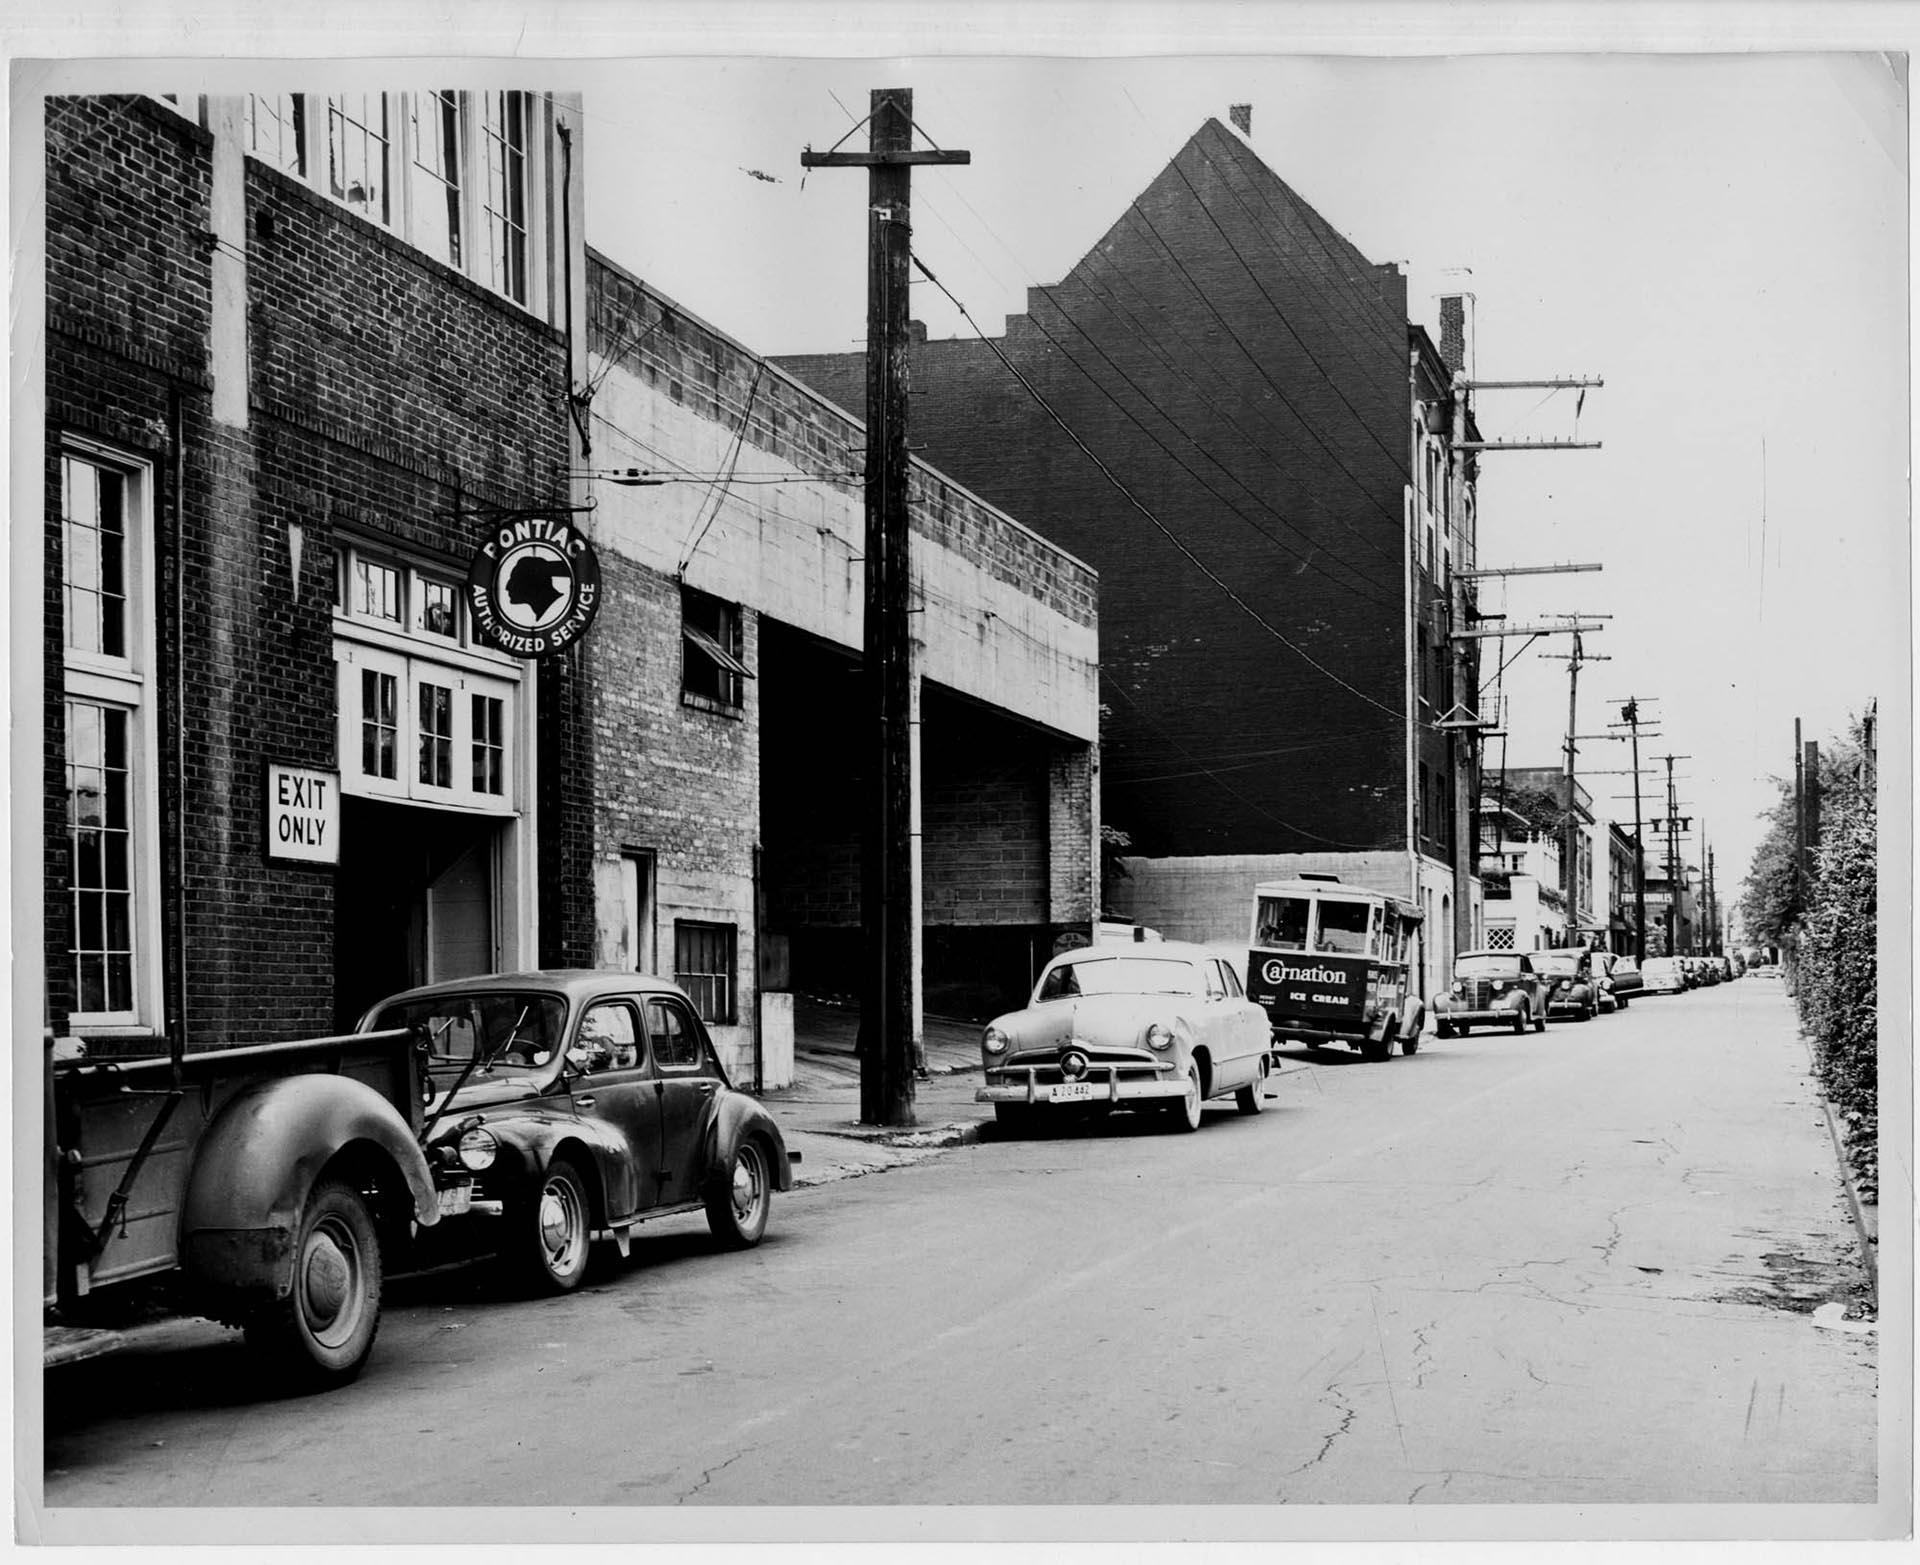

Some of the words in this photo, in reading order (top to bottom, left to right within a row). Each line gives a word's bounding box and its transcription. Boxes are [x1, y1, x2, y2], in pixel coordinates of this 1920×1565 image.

[483, 519, 586, 560] PONTIAC
[473, 584, 545, 652] AUTHORIZED
[551, 583, 595, 647] SERVICE
[278, 773, 326, 810] EXIT
[278, 814, 326, 846] ONLY
[1261, 958, 1347, 985] Carnation
[1289, 992, 1307, 1001] ICE
[1311, 993, 1349, 1005] CREAM
